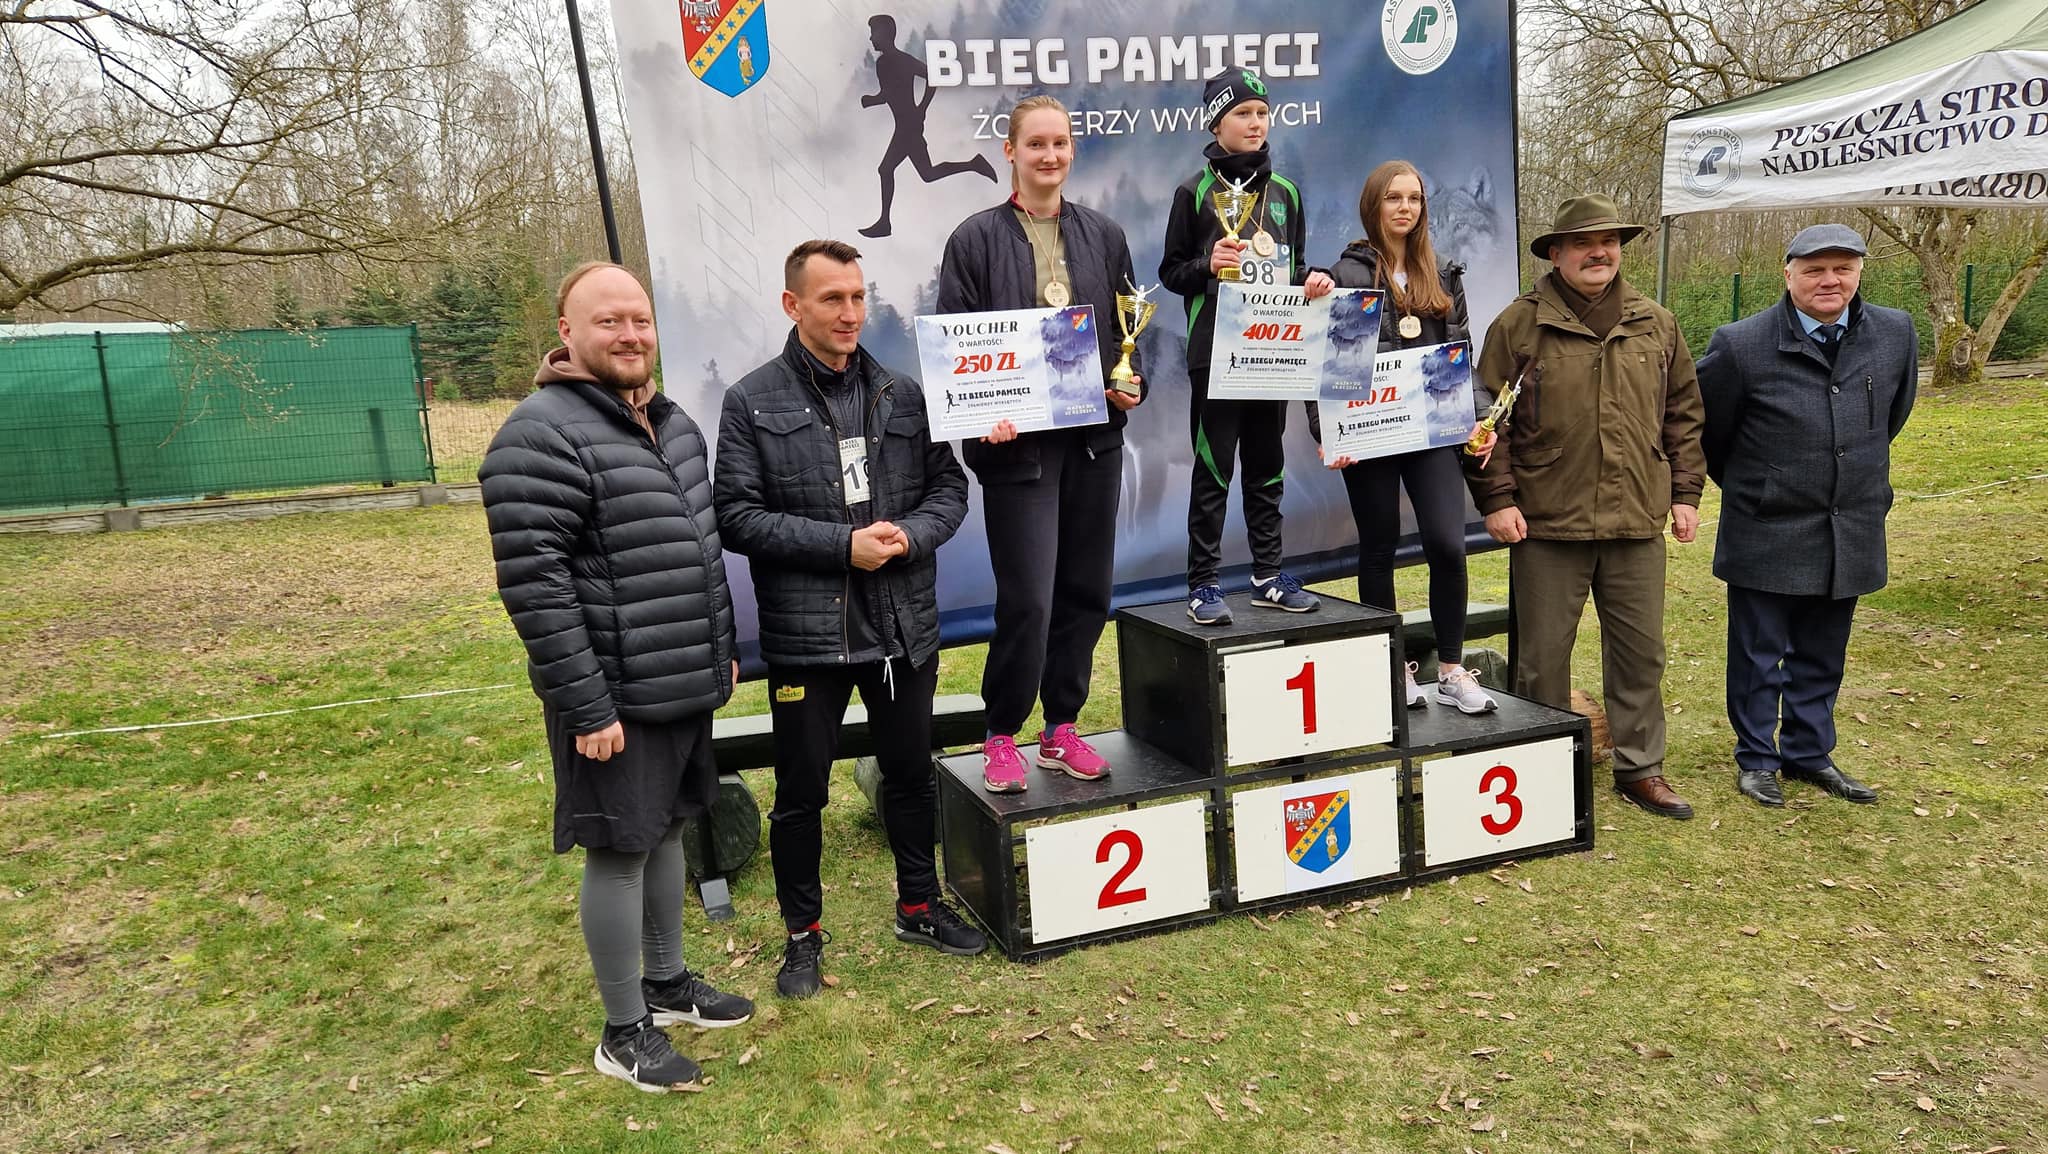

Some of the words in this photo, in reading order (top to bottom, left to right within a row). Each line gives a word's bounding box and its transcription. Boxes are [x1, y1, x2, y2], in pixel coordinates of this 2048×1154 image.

[925, 38, 1070, 87] BIEG
[972, 108, 1140, 139] ŻOERZY
[1769, 99, 1930, 151] PUSZCZA
[1760, 114, 2015, 177] NADLEŚNICTWO
[1242, 261, 1275, 285] 98
[1242, 293, 1311, 307] VOUCHER
[942, 320, 1019, 337] VOUCHER
[1242, 323, 1280, 341] 400
[1281, 324, 1304, 341] ZŁ
[953, 354, 993, 375] 250
[997, 352, 1022, 371] ZŁ
[1250, 357, 1274, 365] BIEGU
[1275, 358, 1308, 366] PAMIĘCI
[958, 392, 968, 401] II
[969, 390, 995, 400] BIEGU
[996, 387, 1031, 397] PAMIĘCI
[1380, 386, 1402, 403] ZŁ
[1357, 420, 1379, 429] BIEGU
[1285, 660, 1317, 735] 1
[1478, 765, 1524, 836] 3
[1095, 829, 1148, 910] 2
